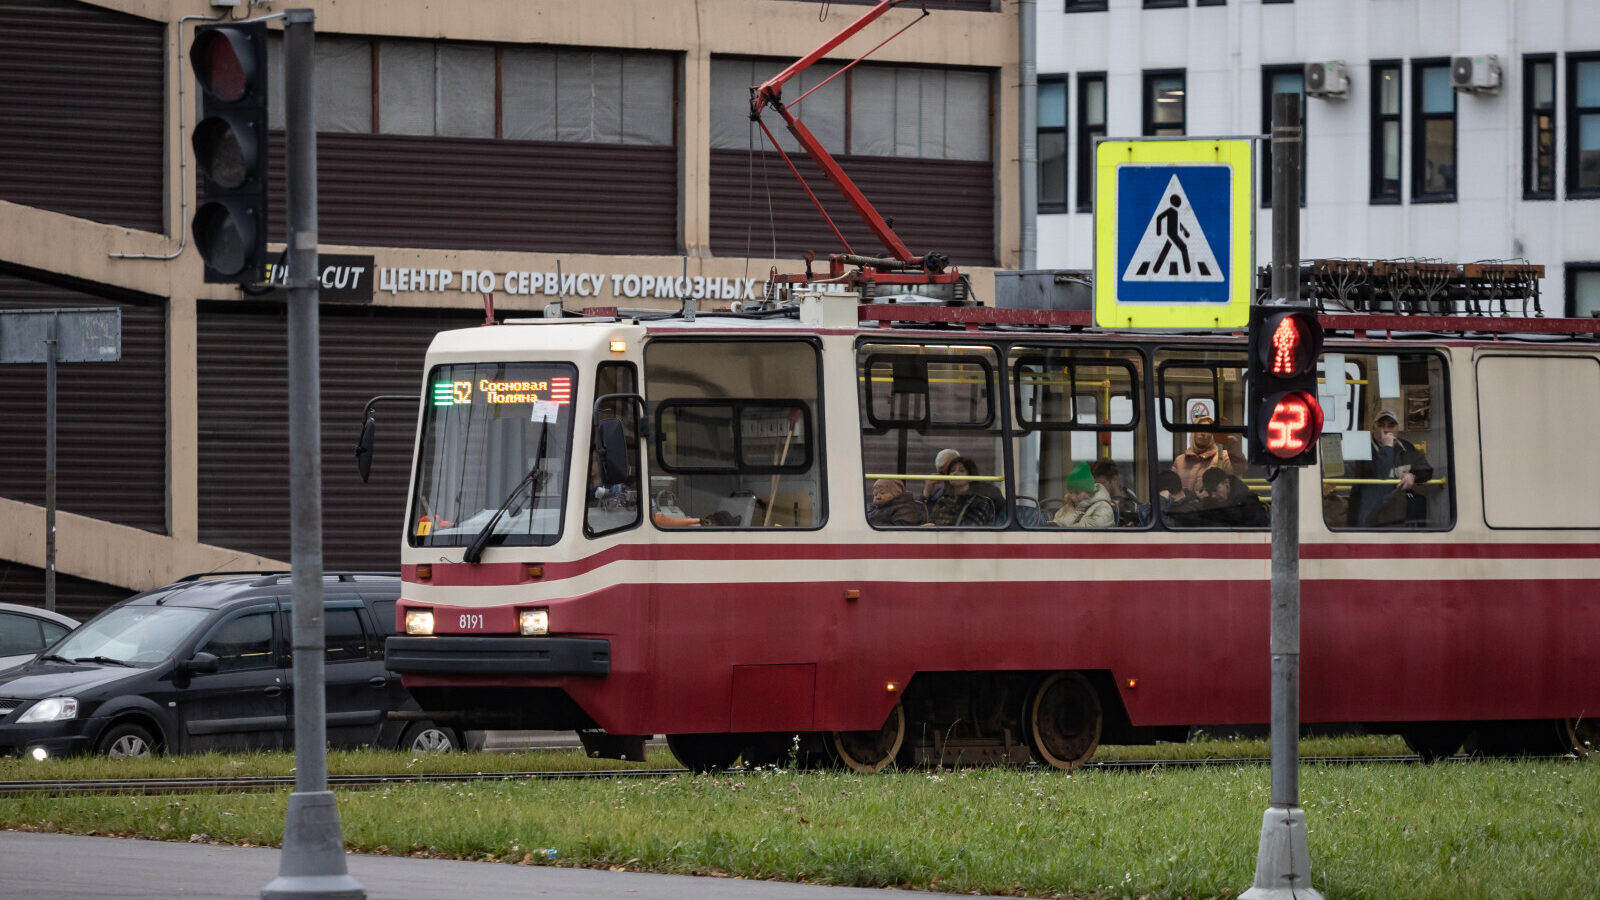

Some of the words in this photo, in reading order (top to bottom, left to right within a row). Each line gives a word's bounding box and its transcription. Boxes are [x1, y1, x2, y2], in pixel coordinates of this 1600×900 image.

[380, 267, 453, 295] ЦЕНТР
[461, 269, 496, 294] ПО
[504, 271, 605, 297] СЕРВИСУ
[611, 273, 757, 300] ТОРМОЗНЫХ
[453, 381, 472, 404] 52
[479, 379, 547, 392] Сосновая
[487, 391, 538, 404] Поляна
[459, 614, 483, 629] 8191
